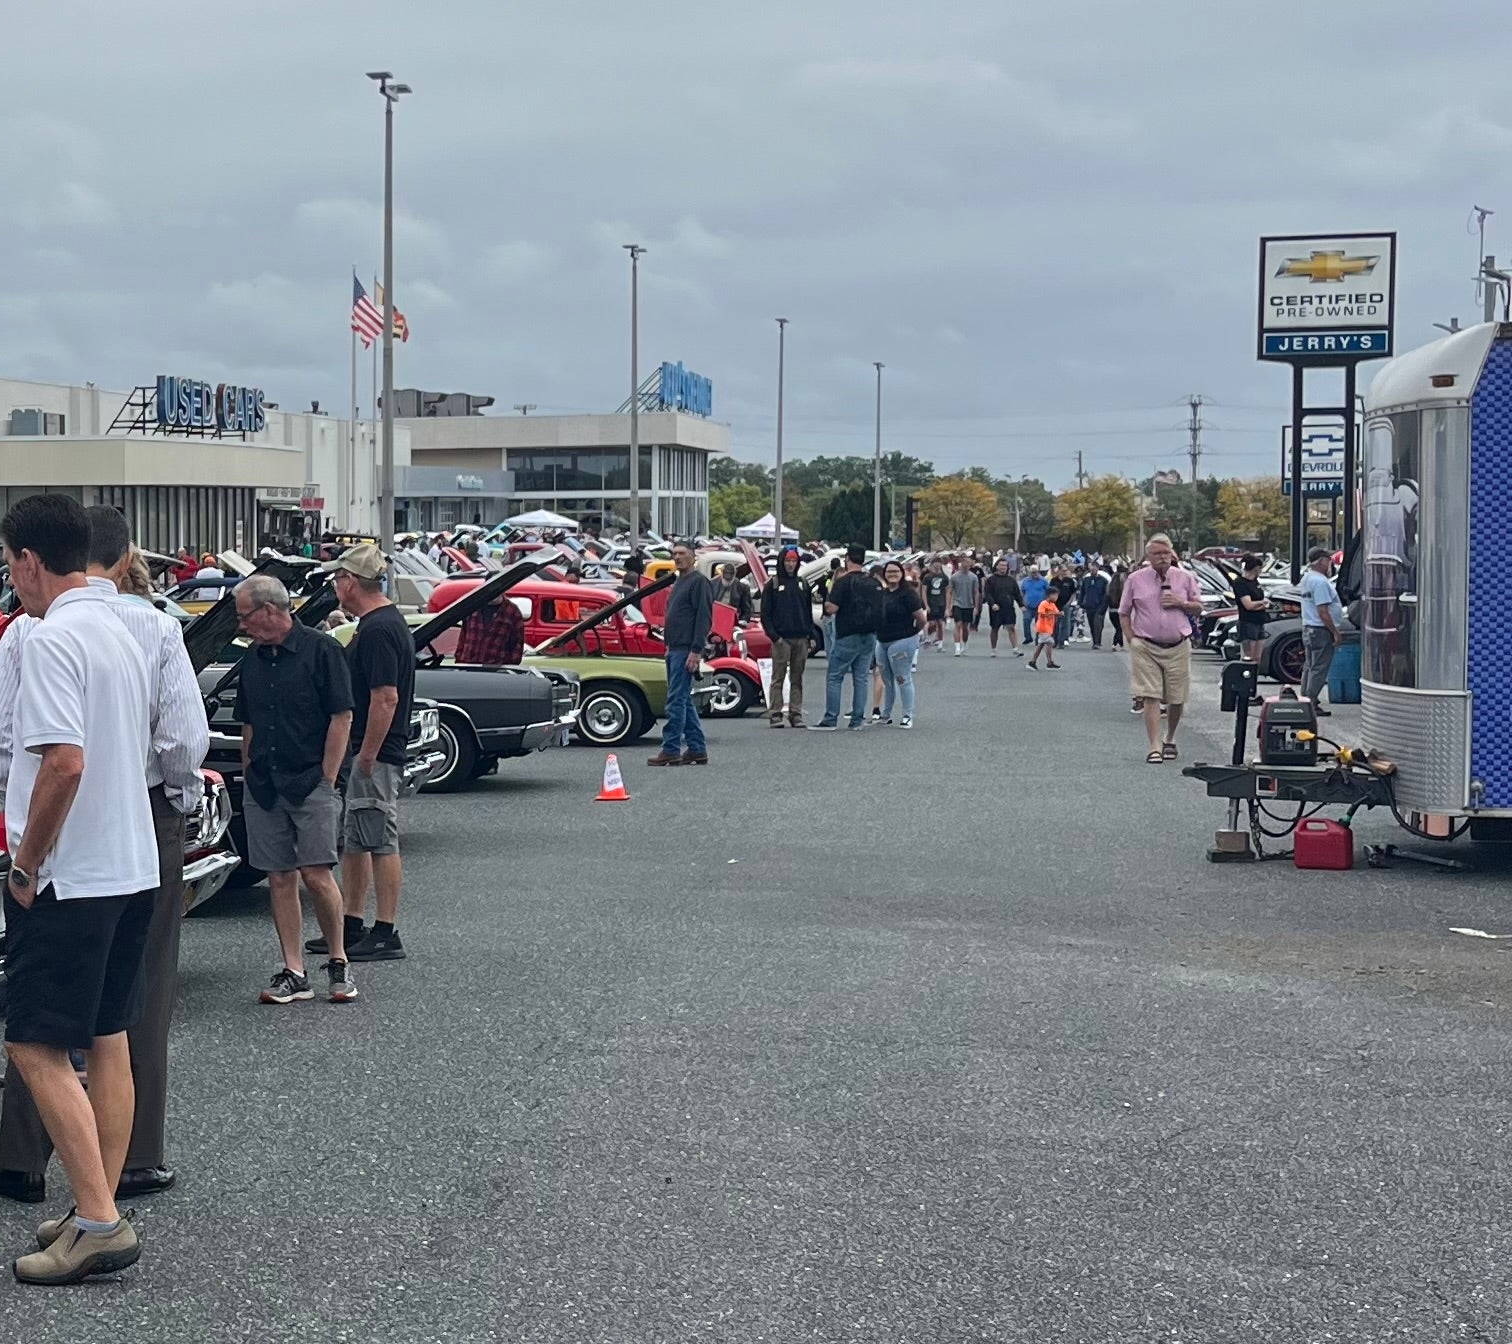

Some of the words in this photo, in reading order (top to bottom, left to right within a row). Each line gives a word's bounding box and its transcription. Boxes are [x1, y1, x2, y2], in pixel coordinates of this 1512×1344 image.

[1270, 293, 1384, 306] CERTIFIED
[1276, 305, 1377, 317] PRE-OWNED
[1278, 335, 1372, 351] JERRY'S
[158, 375, 213, 426] USED
[216, 383, 265, 432] CARS
